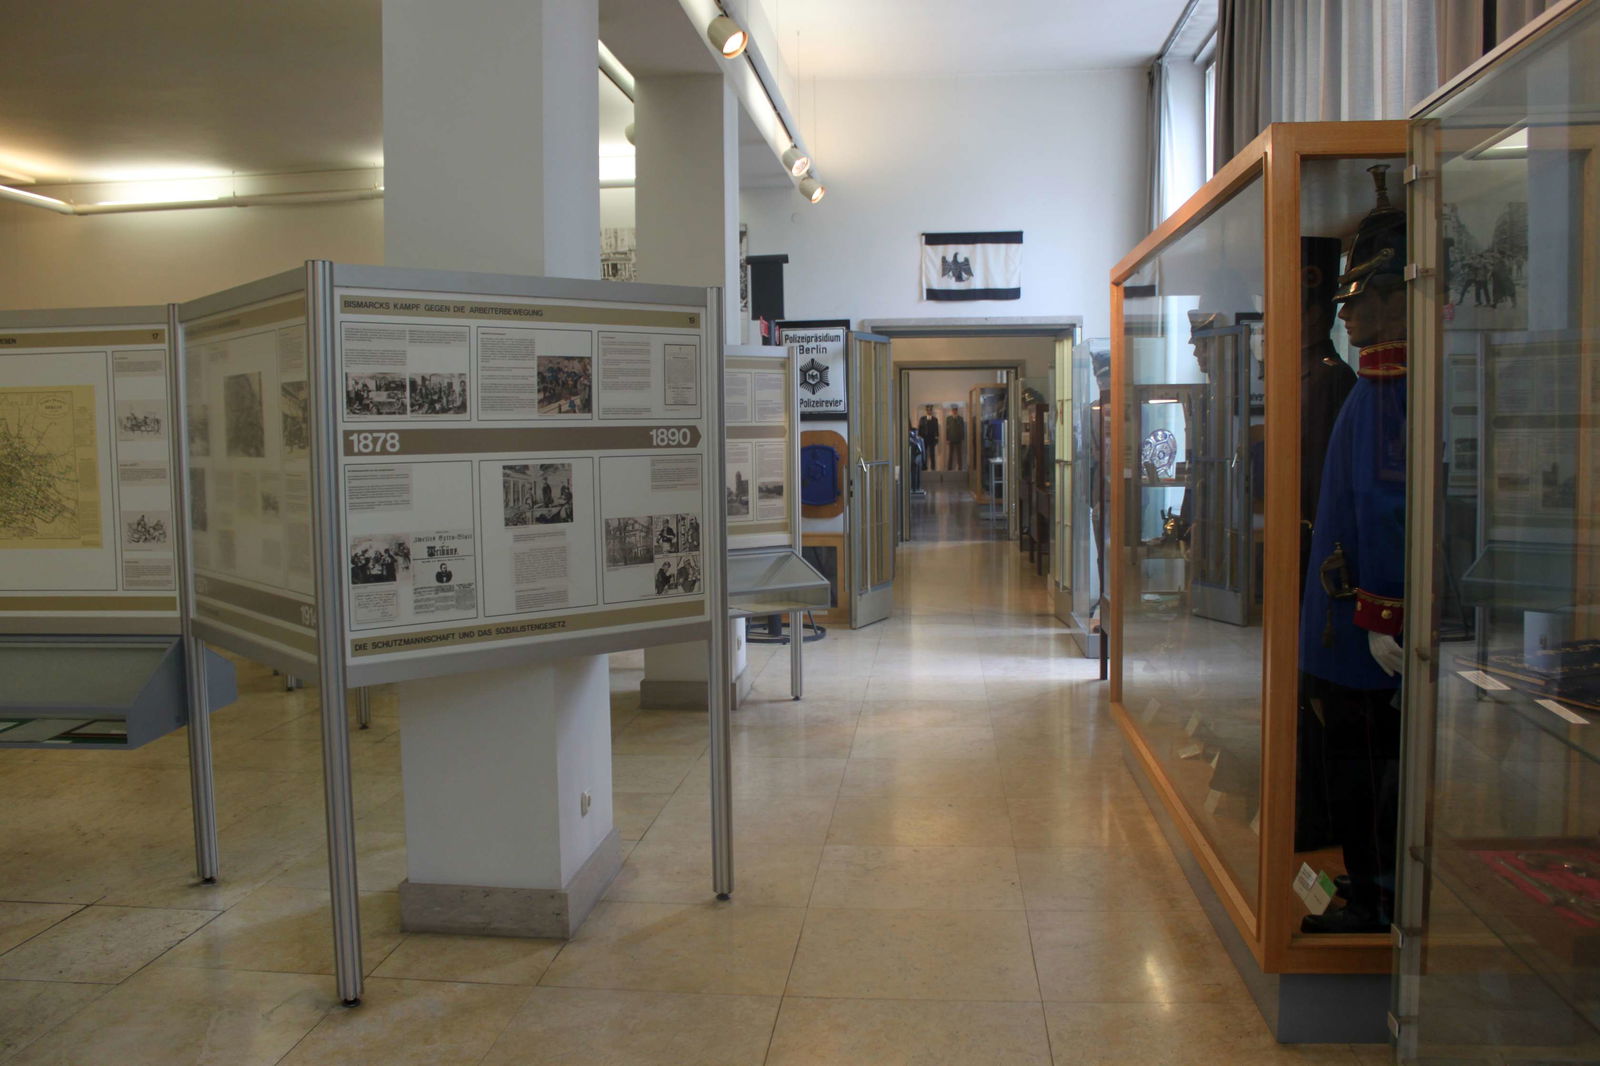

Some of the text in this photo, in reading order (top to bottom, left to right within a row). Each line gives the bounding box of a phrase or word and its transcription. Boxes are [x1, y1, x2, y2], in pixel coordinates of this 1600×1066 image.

[343, 300, 544, 317] BISMARCKS KAMPF GEGEN DIE ARBEITERBEWEGUNG
[784, 332, 841, 345] Polizeipräsidium
[799, 344, 828, 355] Berlin
[800, 398, 843, 408] Polizeirevier
[348, 432, 401, 453] 1878
[649, 427, 691, 447] 1890
[354, 620, 566, 652] DIE SCHUTZMANNSCHAFT UND DAS SOZIALISTENGESETZ
